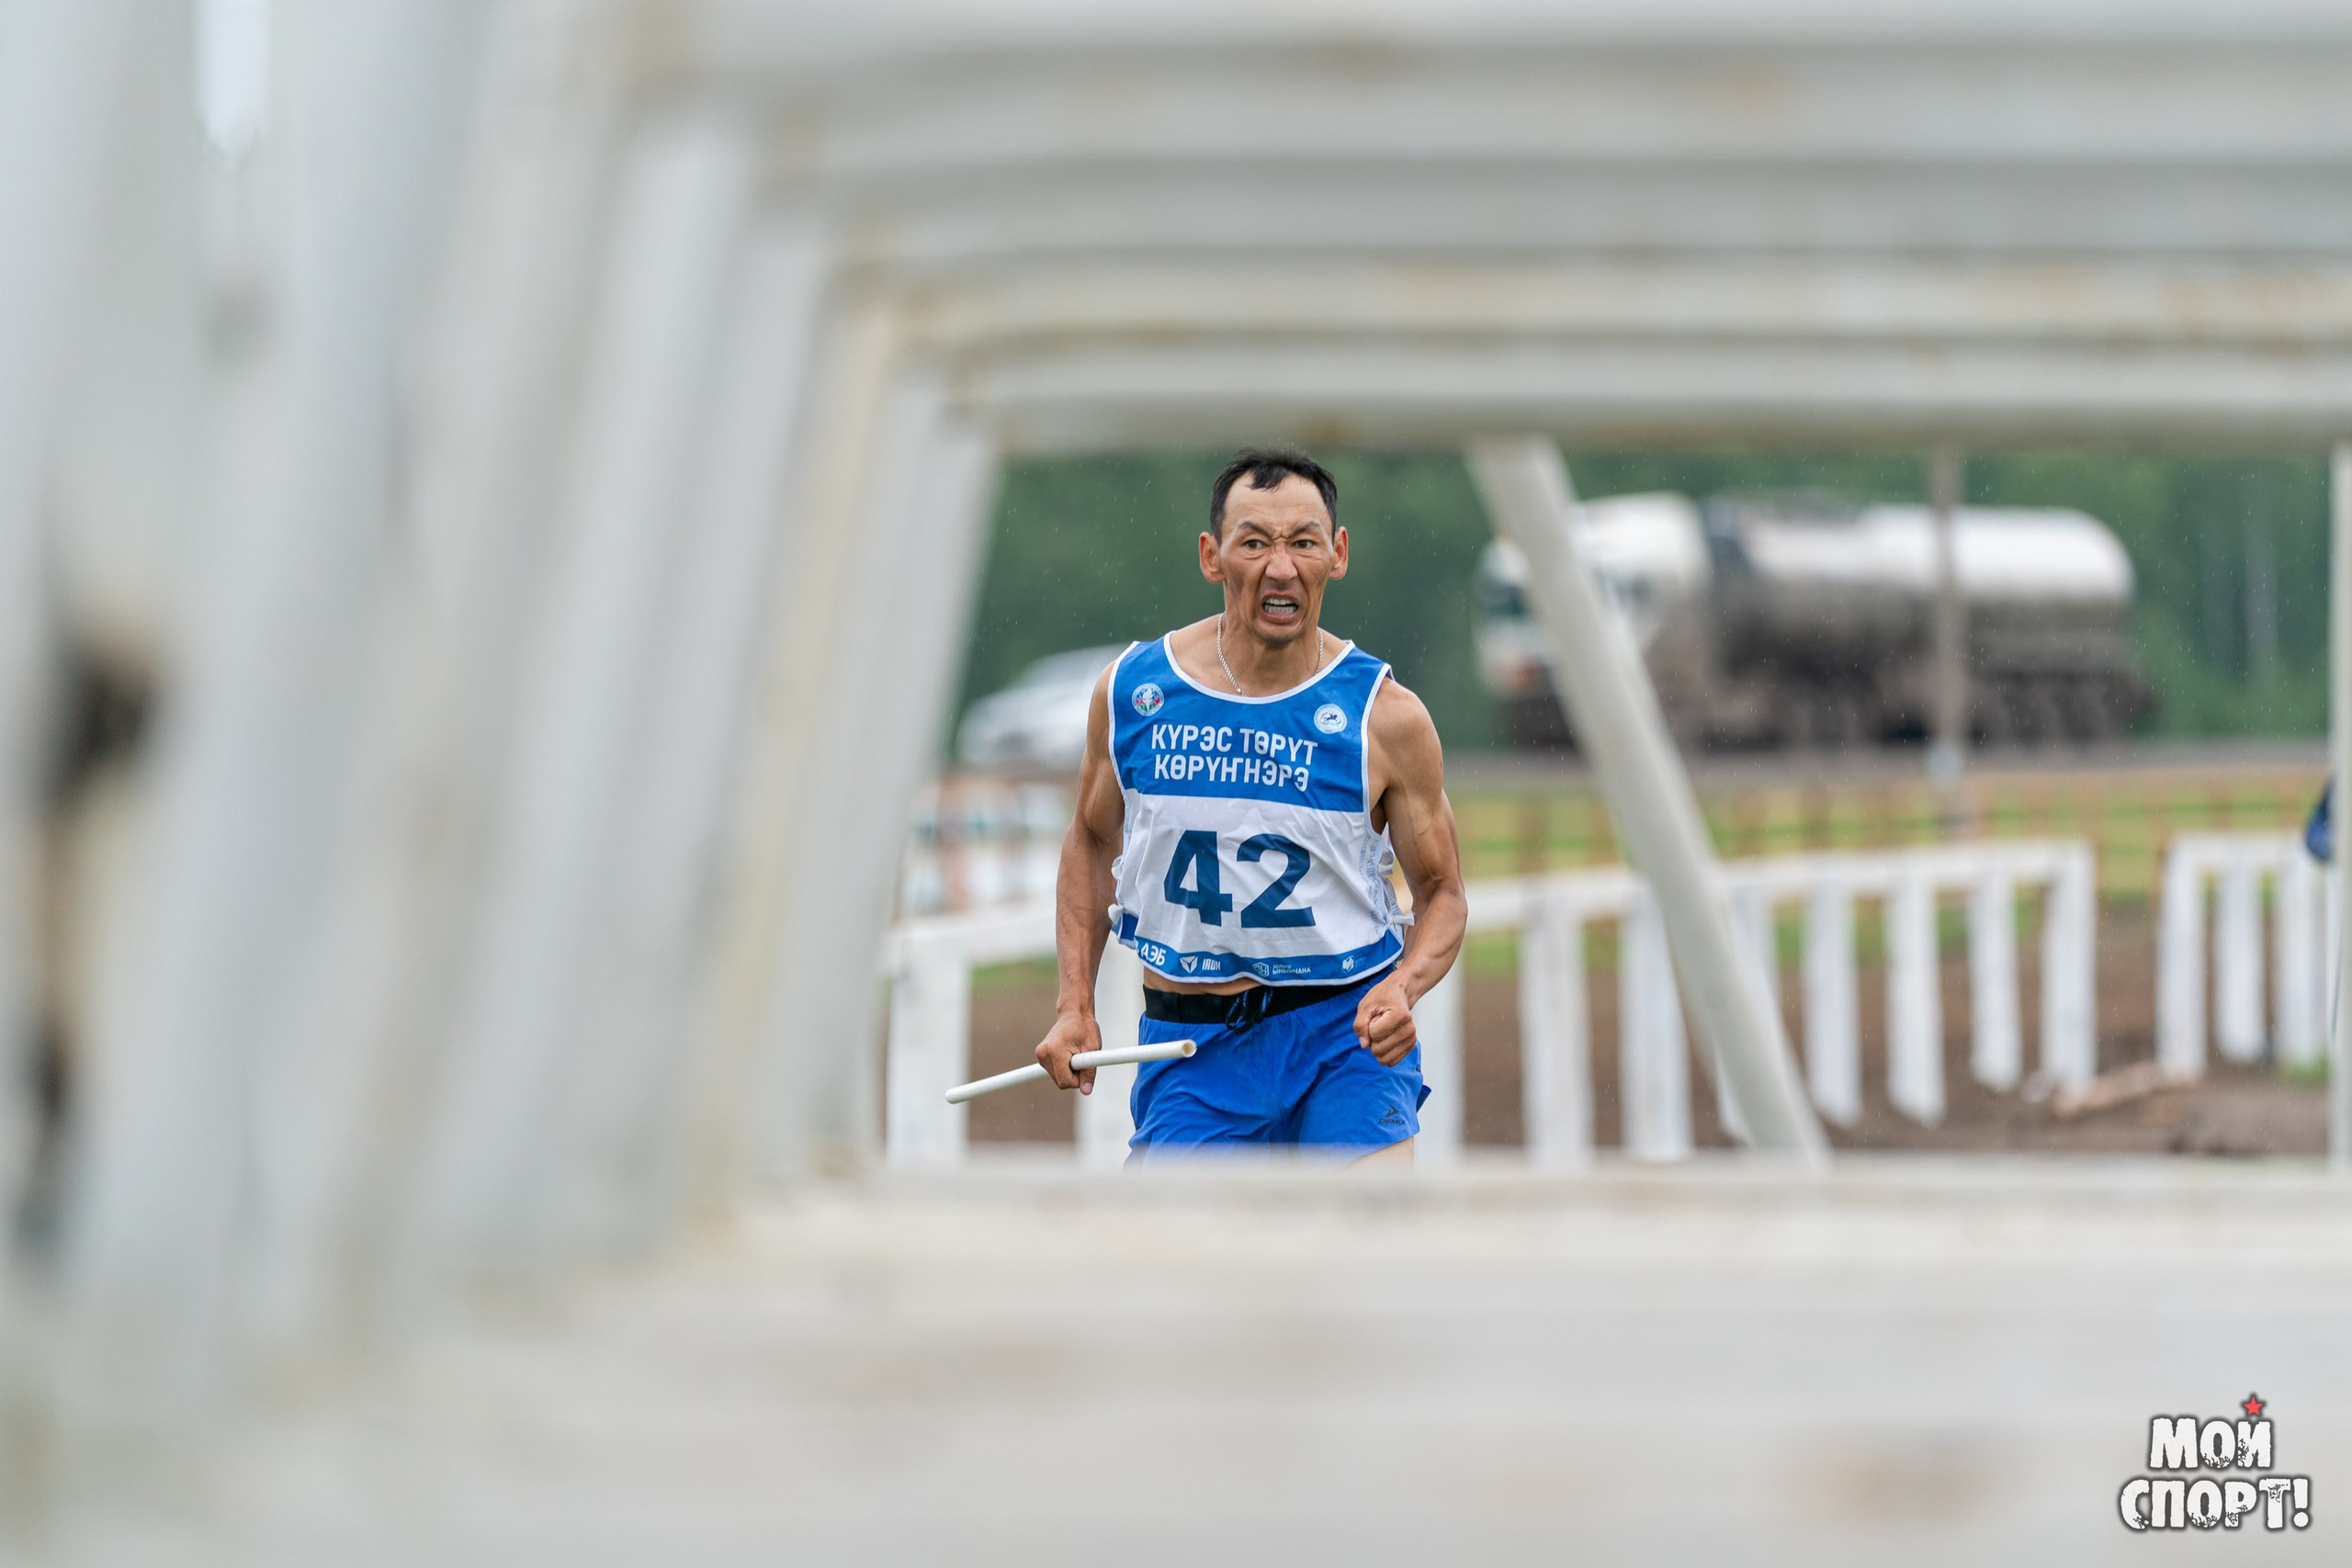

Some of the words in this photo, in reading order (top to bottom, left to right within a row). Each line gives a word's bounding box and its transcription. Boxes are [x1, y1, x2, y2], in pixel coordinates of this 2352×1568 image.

[1151, 724, 1232, 752] КҮРЭС
[1239, 728, 1317, 765] ТӨРҮТ
[1164, 829, 1316, 928] 42
[1141, 942, 1167, 966] АЭБ
[1378, 1118, 1407, 1126] DEMIX
